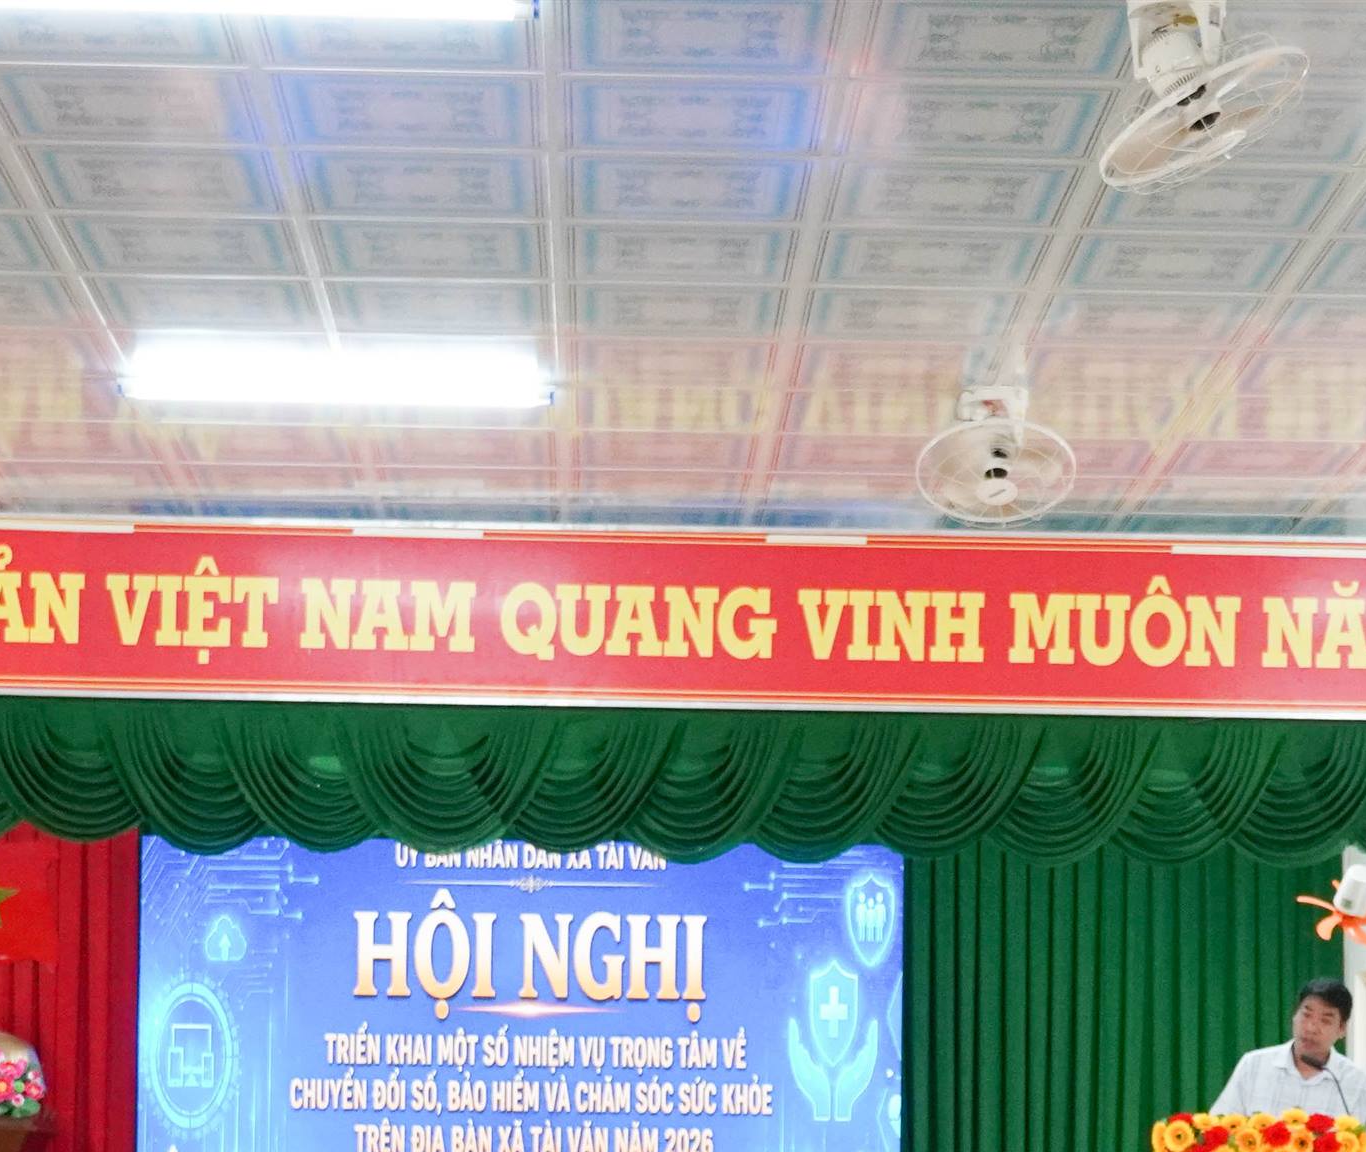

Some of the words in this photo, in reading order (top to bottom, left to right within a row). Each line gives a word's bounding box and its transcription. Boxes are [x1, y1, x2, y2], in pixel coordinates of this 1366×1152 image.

[107, 555, 280, 664] VIỆT
[300, 578, 475, 654] NAM
[500, 583, 776, 661] QUANG
[800, 588, 985, 662] VINH
[1010, 574, 1236, 667] MUÔN
[466, 840, 519, 869] NHÂN
[595, 841, 624, 870] TÀI
[354, 889, 498, 1020] HỘI
[519, 912, 706, 1022] NGHỊ
[324, 1022, 380, 1064] TRIỂN
[386, 1035, 432, 1065] KHAI
[438, 1028, 478, 1072] MỘT
[483, 1024, 509, 1066] SỐ
[515, 1029, 574, 1073] NHIỆM
[579, 1036, 605, 1074] VỤ
[610, 1037, 673, 1074] TRỌNG
[678, 1031, 717, 1069] TÂM
[721, 1027, 747, 1069] VỀ
[290, 1067, 367, 1110] CHUYỂN
[373, 1067, 405, 1110] ĐỔI
[411, 1070, 442, 1116] SỐ,
[447, 1072, 487, 1112] BẢO
[492, 1068, 539, 1112] HIỂM
[544, 1075, 570, 1112] VÀ
[575, 1076, 630, 1113] CHĂM
[635, 1075, 673, 1114] SÓC
[679, 1077, 716, 1114] SỨC
[722, 1074, 773, 1115] KHỎE
